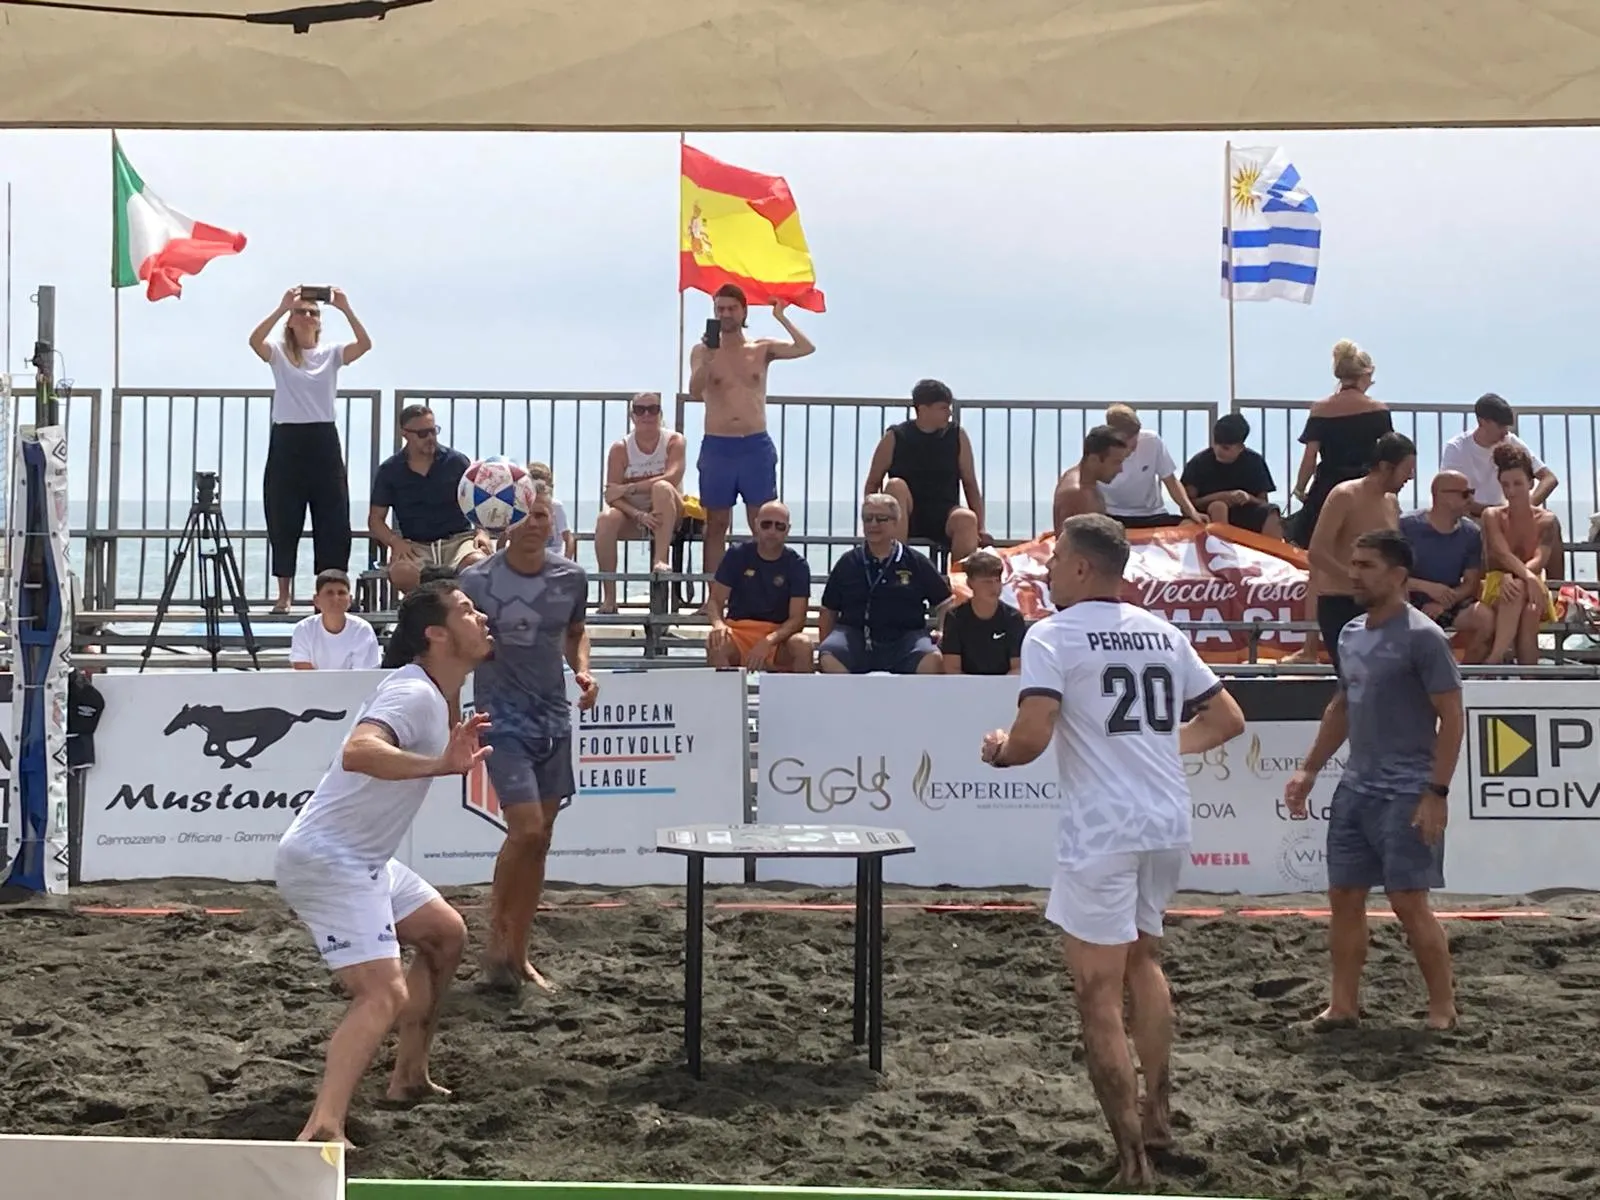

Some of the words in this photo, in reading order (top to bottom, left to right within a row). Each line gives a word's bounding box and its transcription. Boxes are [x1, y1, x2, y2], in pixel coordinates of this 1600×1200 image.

[1086, 632, 1174, 651] PERROTTA
[1101, 663, 1175, 735] 20
[579, 703, 674, 723] EUROPEAN
[579, 735, 695, 755] FOOTVOLLEY
[1549, 718, 1600, 767] P
[579, 768, 648, 788] LEAGUE
[105, 783, 315, 816] Mustang
[931, 782, 1063, 800] EXPERIENC
[177, 831, 222, 843] Officina
